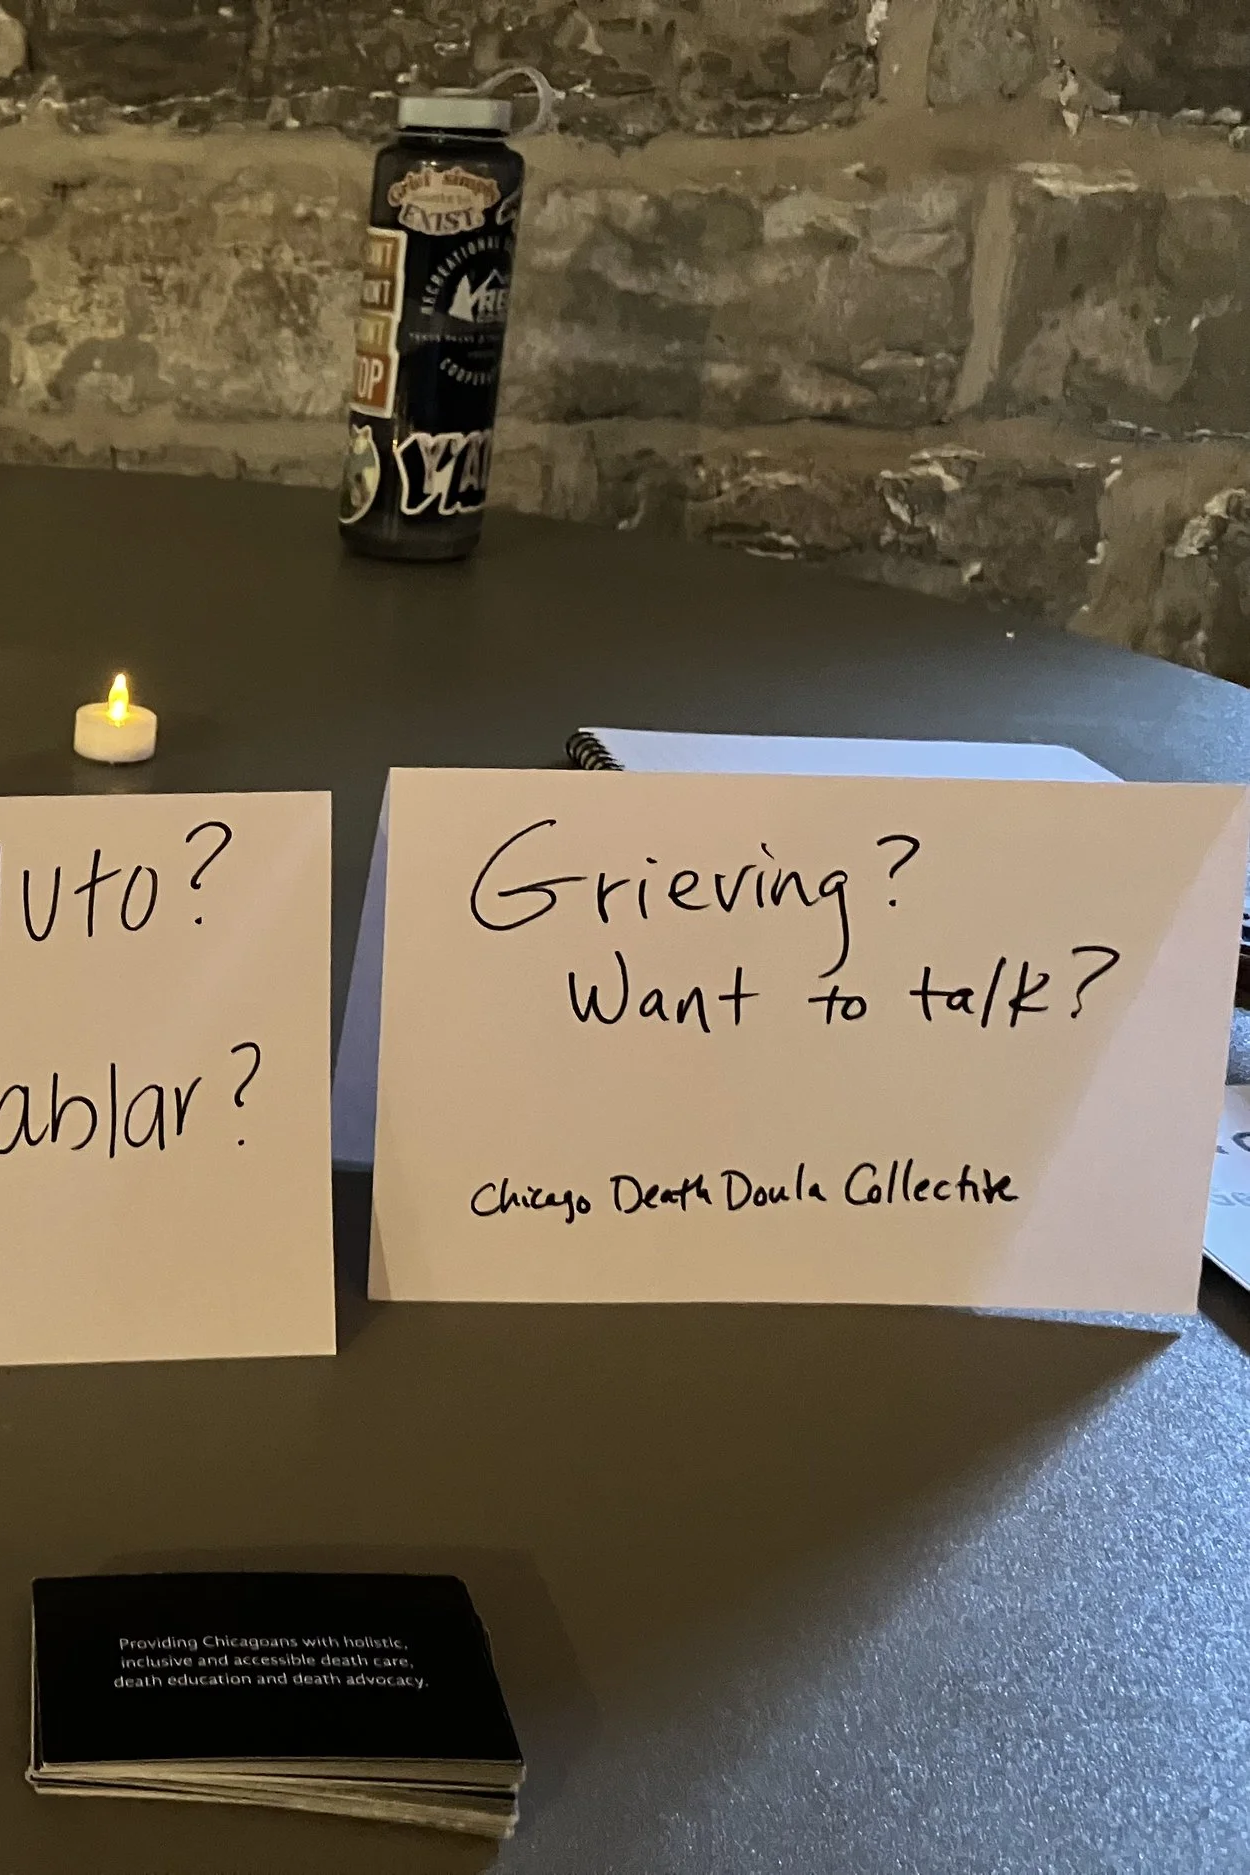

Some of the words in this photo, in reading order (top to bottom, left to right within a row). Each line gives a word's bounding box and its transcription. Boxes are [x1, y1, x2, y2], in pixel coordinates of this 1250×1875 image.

[470, 819, 921, 978] Grieving?
[568, 950, 760, 1033] Want
[807, 985, 868, 1025] to
[909, 945, 1121, 1029] talk?
[470, 1177, 591, 1225] Chicago
[609, 1173, 713, 1215] Death
[720, 1162, 827, 1211] Doula
[844, 1158, 1020, 1206] Collective
[119, 1637, 198, 1651] Providing
[202, 1636, 298, 1650] Chicagoans
[302, 1635, 339, 1648] with
[344, 1635, 409, 1650] holistic,
[121, 1656, 193, 1669] inclusive
[197, 1655, 229, 1667] and
[233, 1654, 316, 1667] accessible
[320, 1654, 369, 1667] death
[373, 1656, 414, 1669] care,
[114, 1675, 163, 1689] death
[167, 1674, 252, 1686] education
[256, 1673, 288, 1685] and
[292, 1673, 341, 1686] death
[346, 1673, 429, 1690] advocacy.
